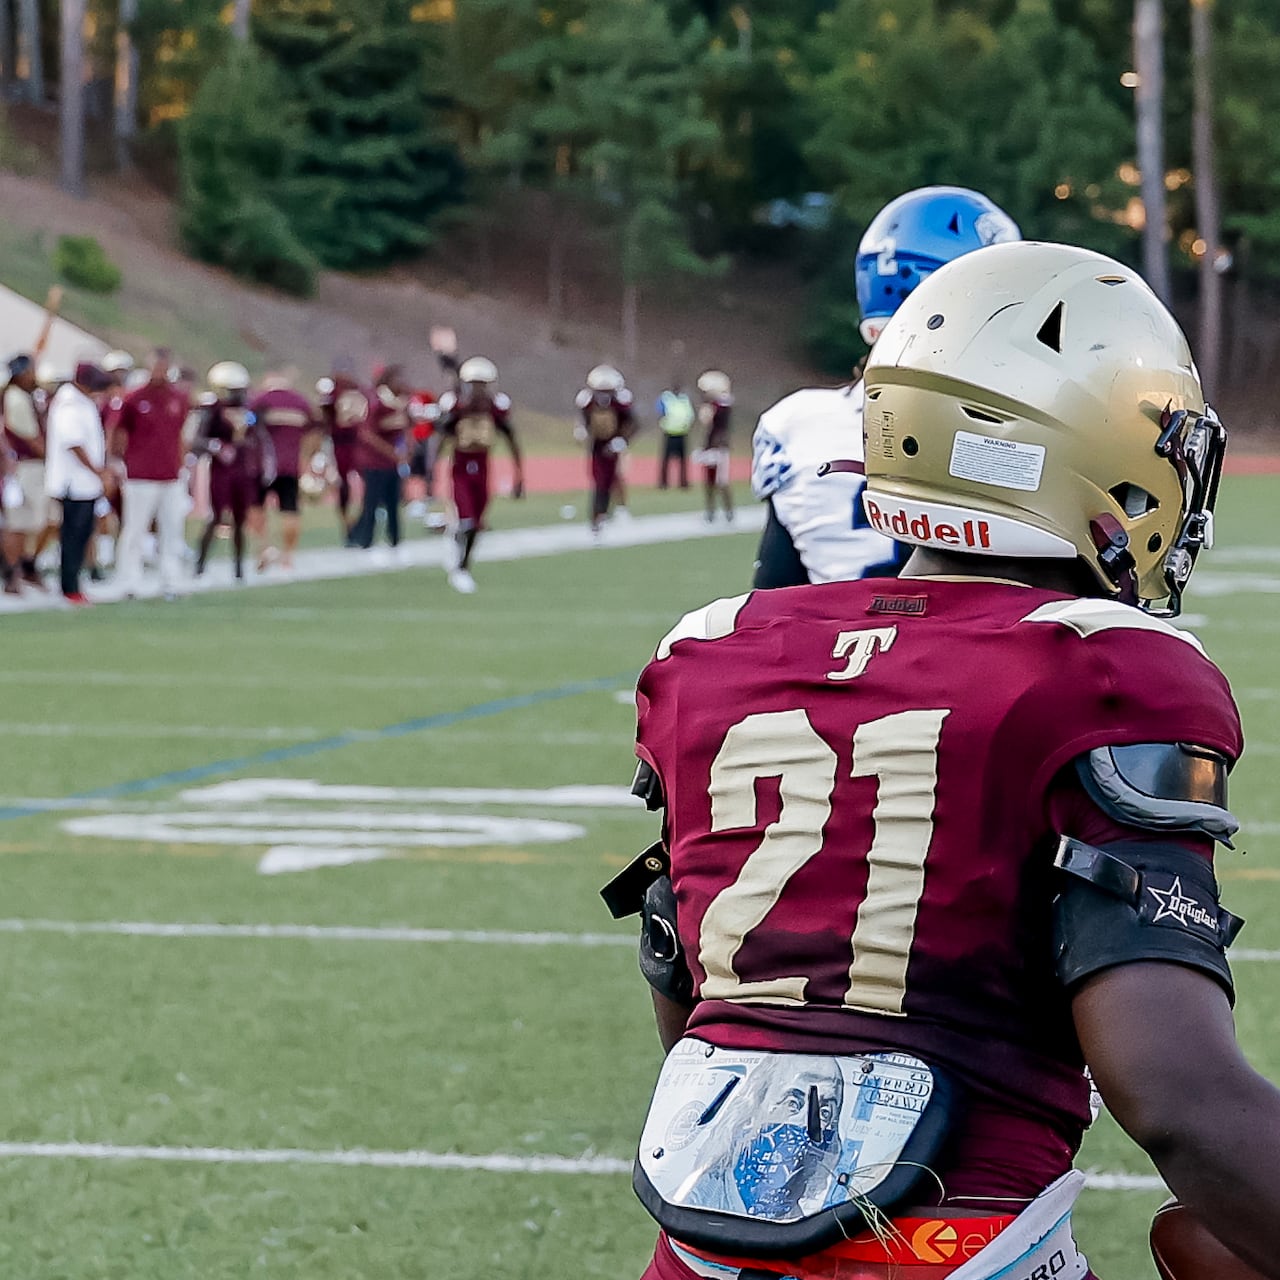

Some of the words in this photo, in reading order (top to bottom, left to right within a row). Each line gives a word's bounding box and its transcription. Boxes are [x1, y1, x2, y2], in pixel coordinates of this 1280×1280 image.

[983, 437, 1017, 450] WARNING
[867, 500, 991, 549] Riddell
[825, 625, 898, 681] T
[699, 708, 951, 1016] 21
[1168, 895, 1219, 929] Douglas
